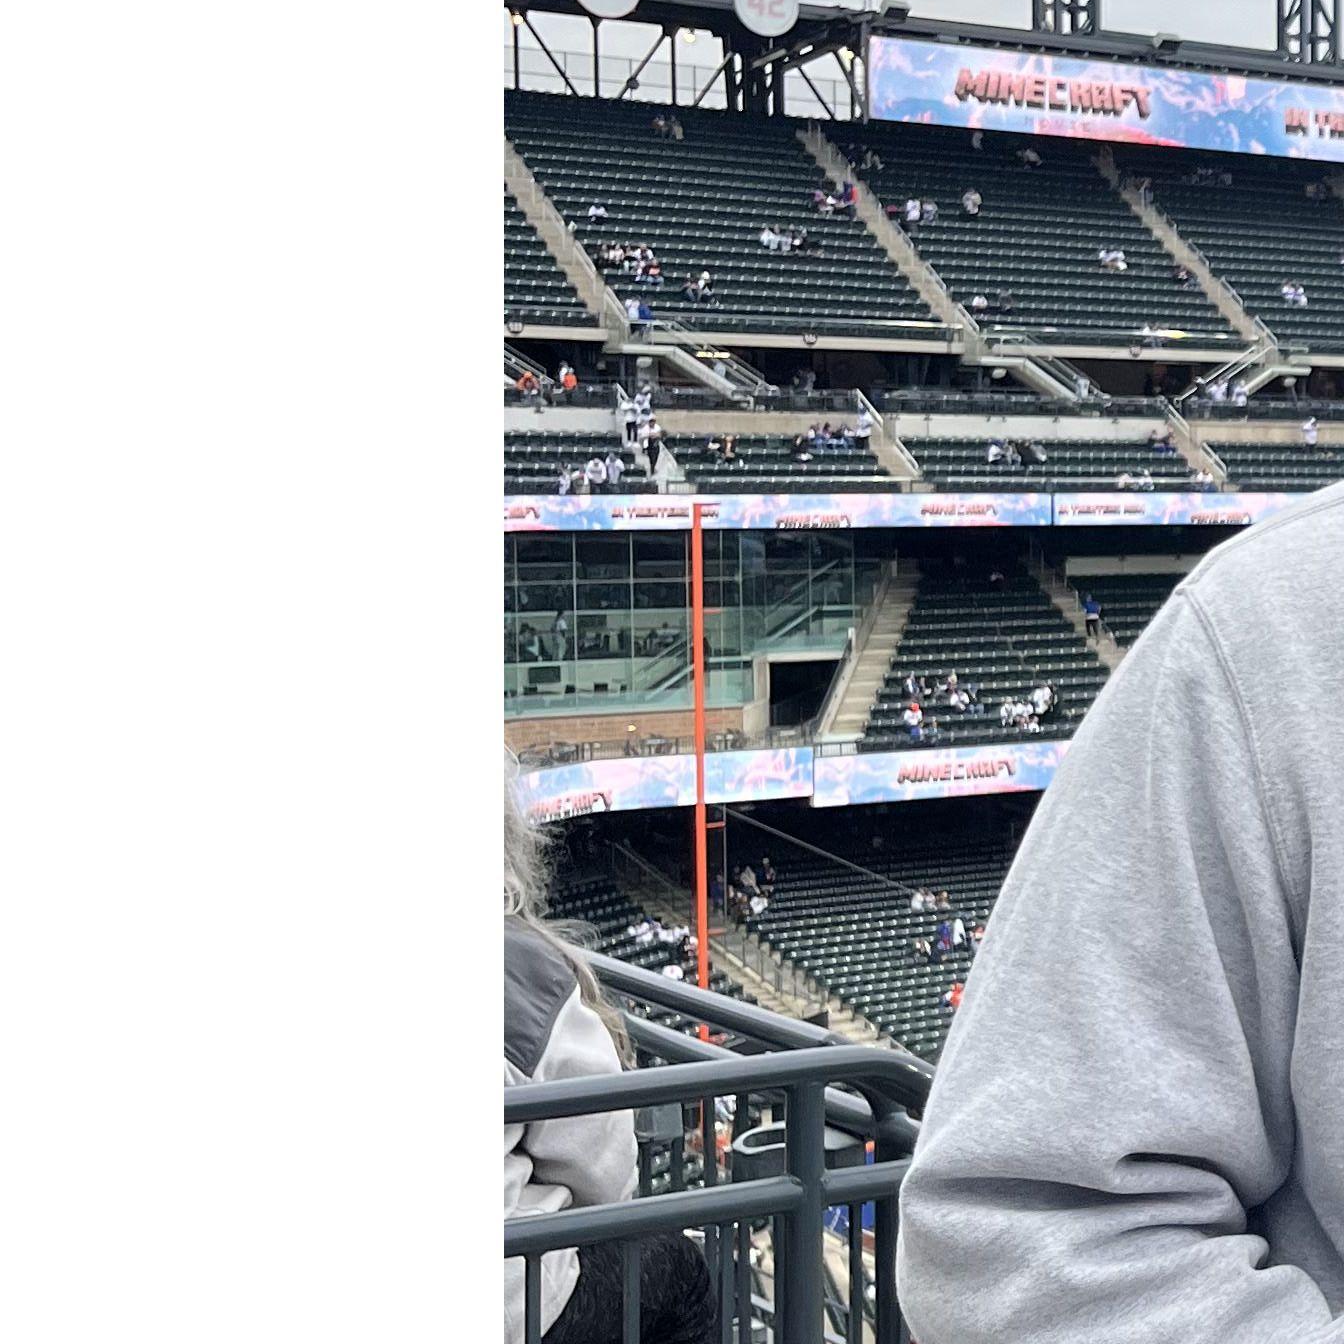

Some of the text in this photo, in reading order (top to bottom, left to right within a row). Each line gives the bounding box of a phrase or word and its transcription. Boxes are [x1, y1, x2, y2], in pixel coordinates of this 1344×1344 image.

[954, 68, 1150, 121] MINECRAFT
[1285, 107, 1308, 136] IN
[897, 756, 1017, 785] MINECRAFT
